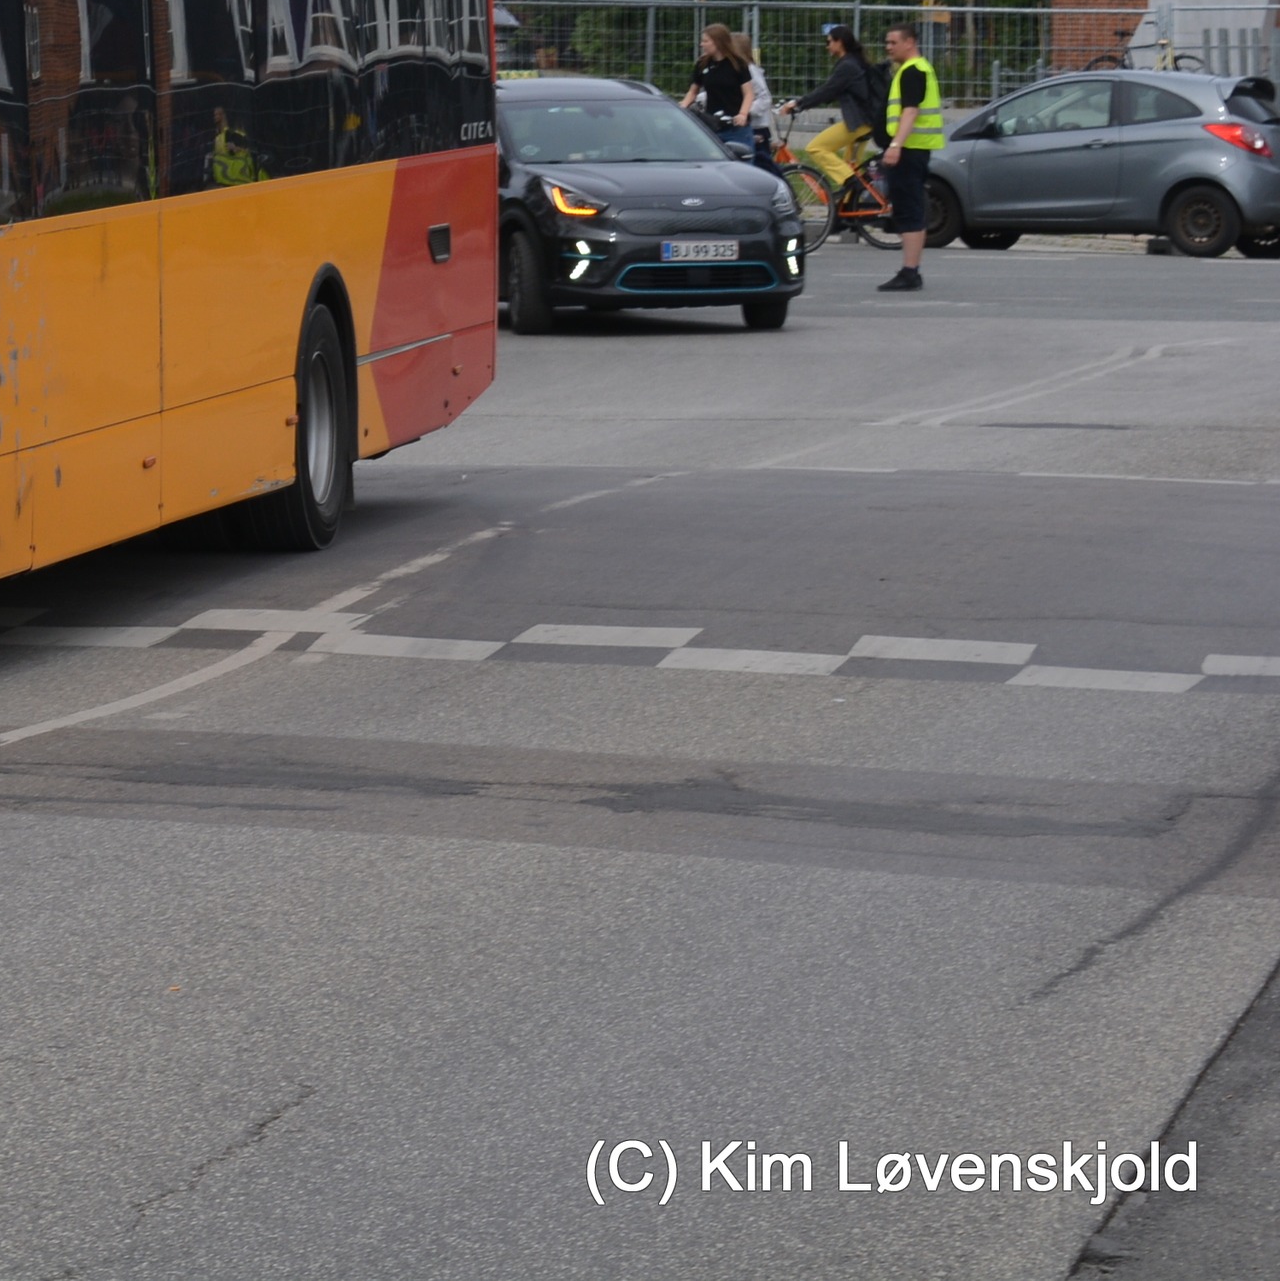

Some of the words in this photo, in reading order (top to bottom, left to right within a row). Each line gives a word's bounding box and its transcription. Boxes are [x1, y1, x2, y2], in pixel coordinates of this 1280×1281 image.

[460, 120, 493, 141] CITEA
[672, 244, 690, 258] BJ
[692, 244, 710, 258] 99
[712, 244, 735, 258] 325
